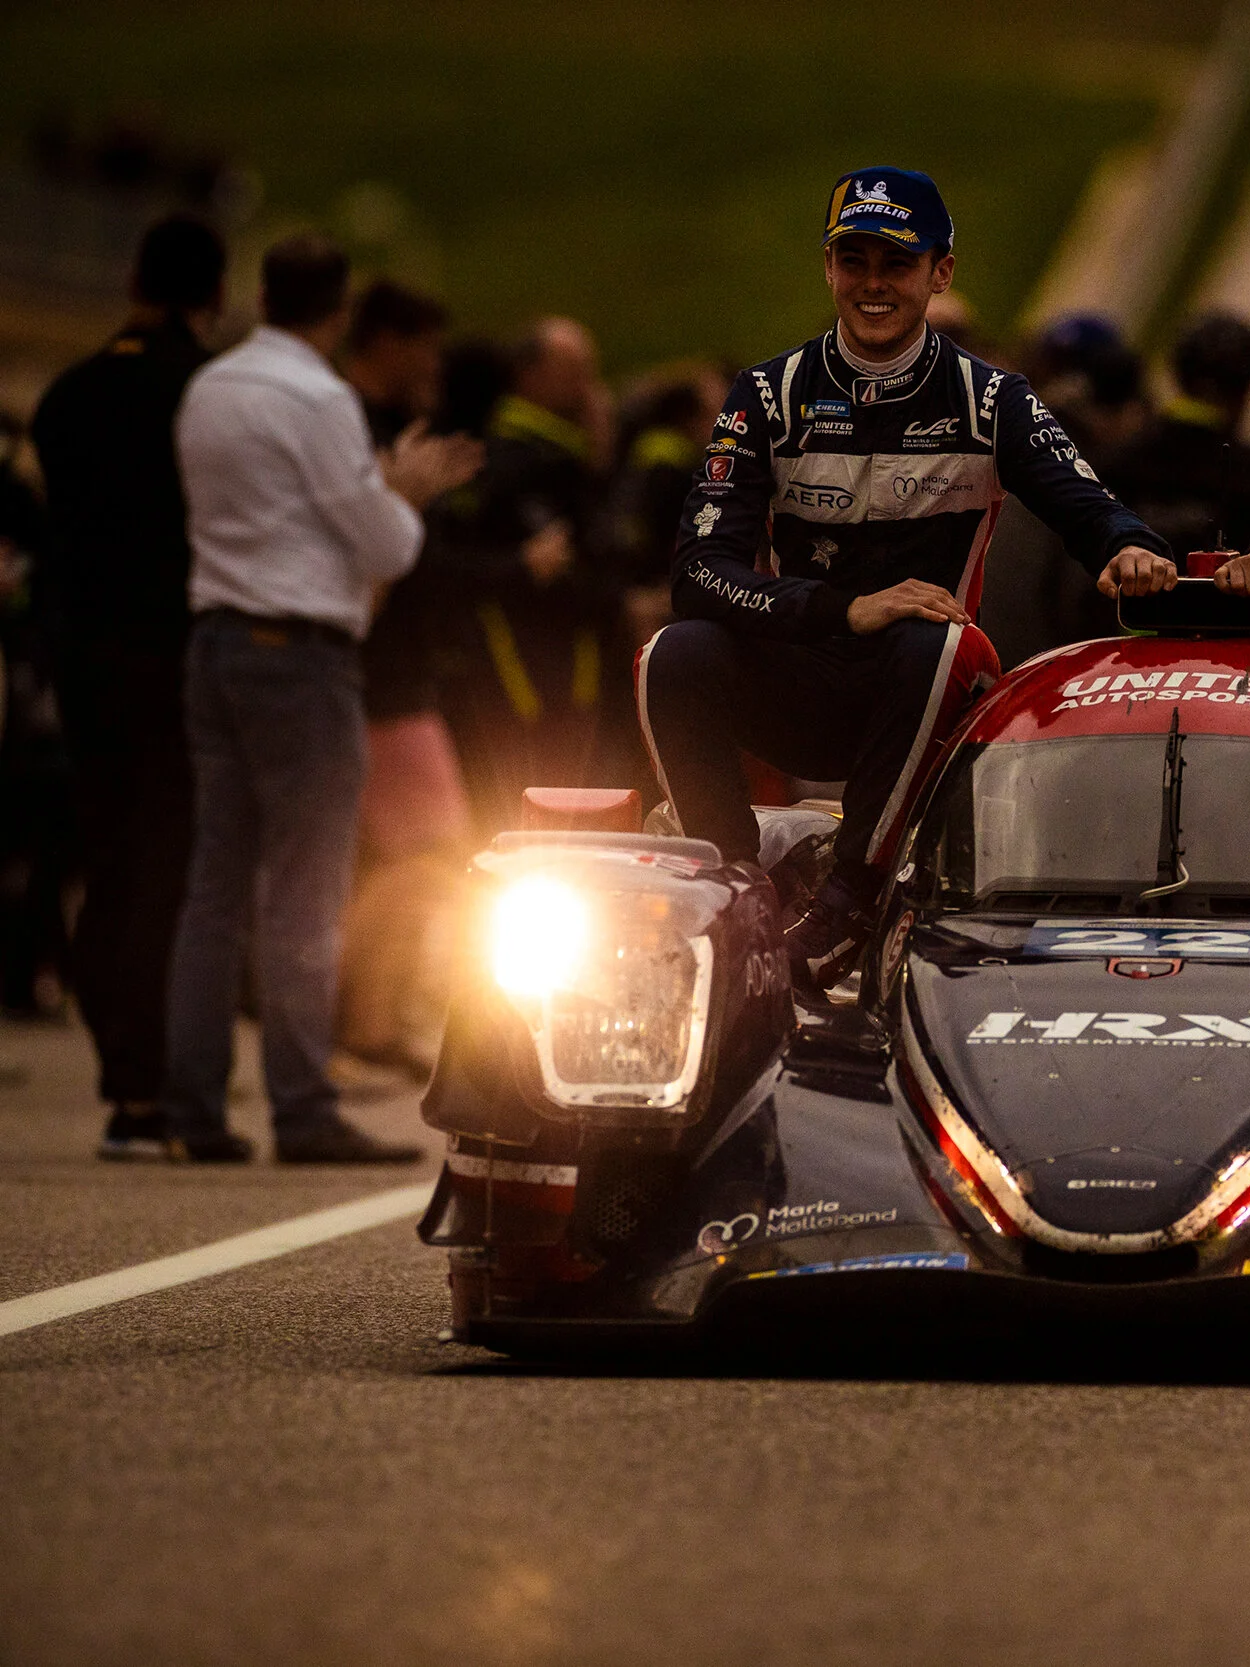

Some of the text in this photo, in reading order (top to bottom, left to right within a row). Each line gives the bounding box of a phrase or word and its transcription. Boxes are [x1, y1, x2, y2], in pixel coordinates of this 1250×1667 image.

[840, 204, 911, 221] MICHELIN
[752, 371, 782, 422] HRX
[979, 370, 1006, 421] HRX
[814, 421, 854, 431] UNITED
[923, 475, 949, 485] Maria
[783, 488, 854, 509] AERO
[768, 1200, 840, 1221] Maria
[765, 1207, 897, 1237] Mallaband
